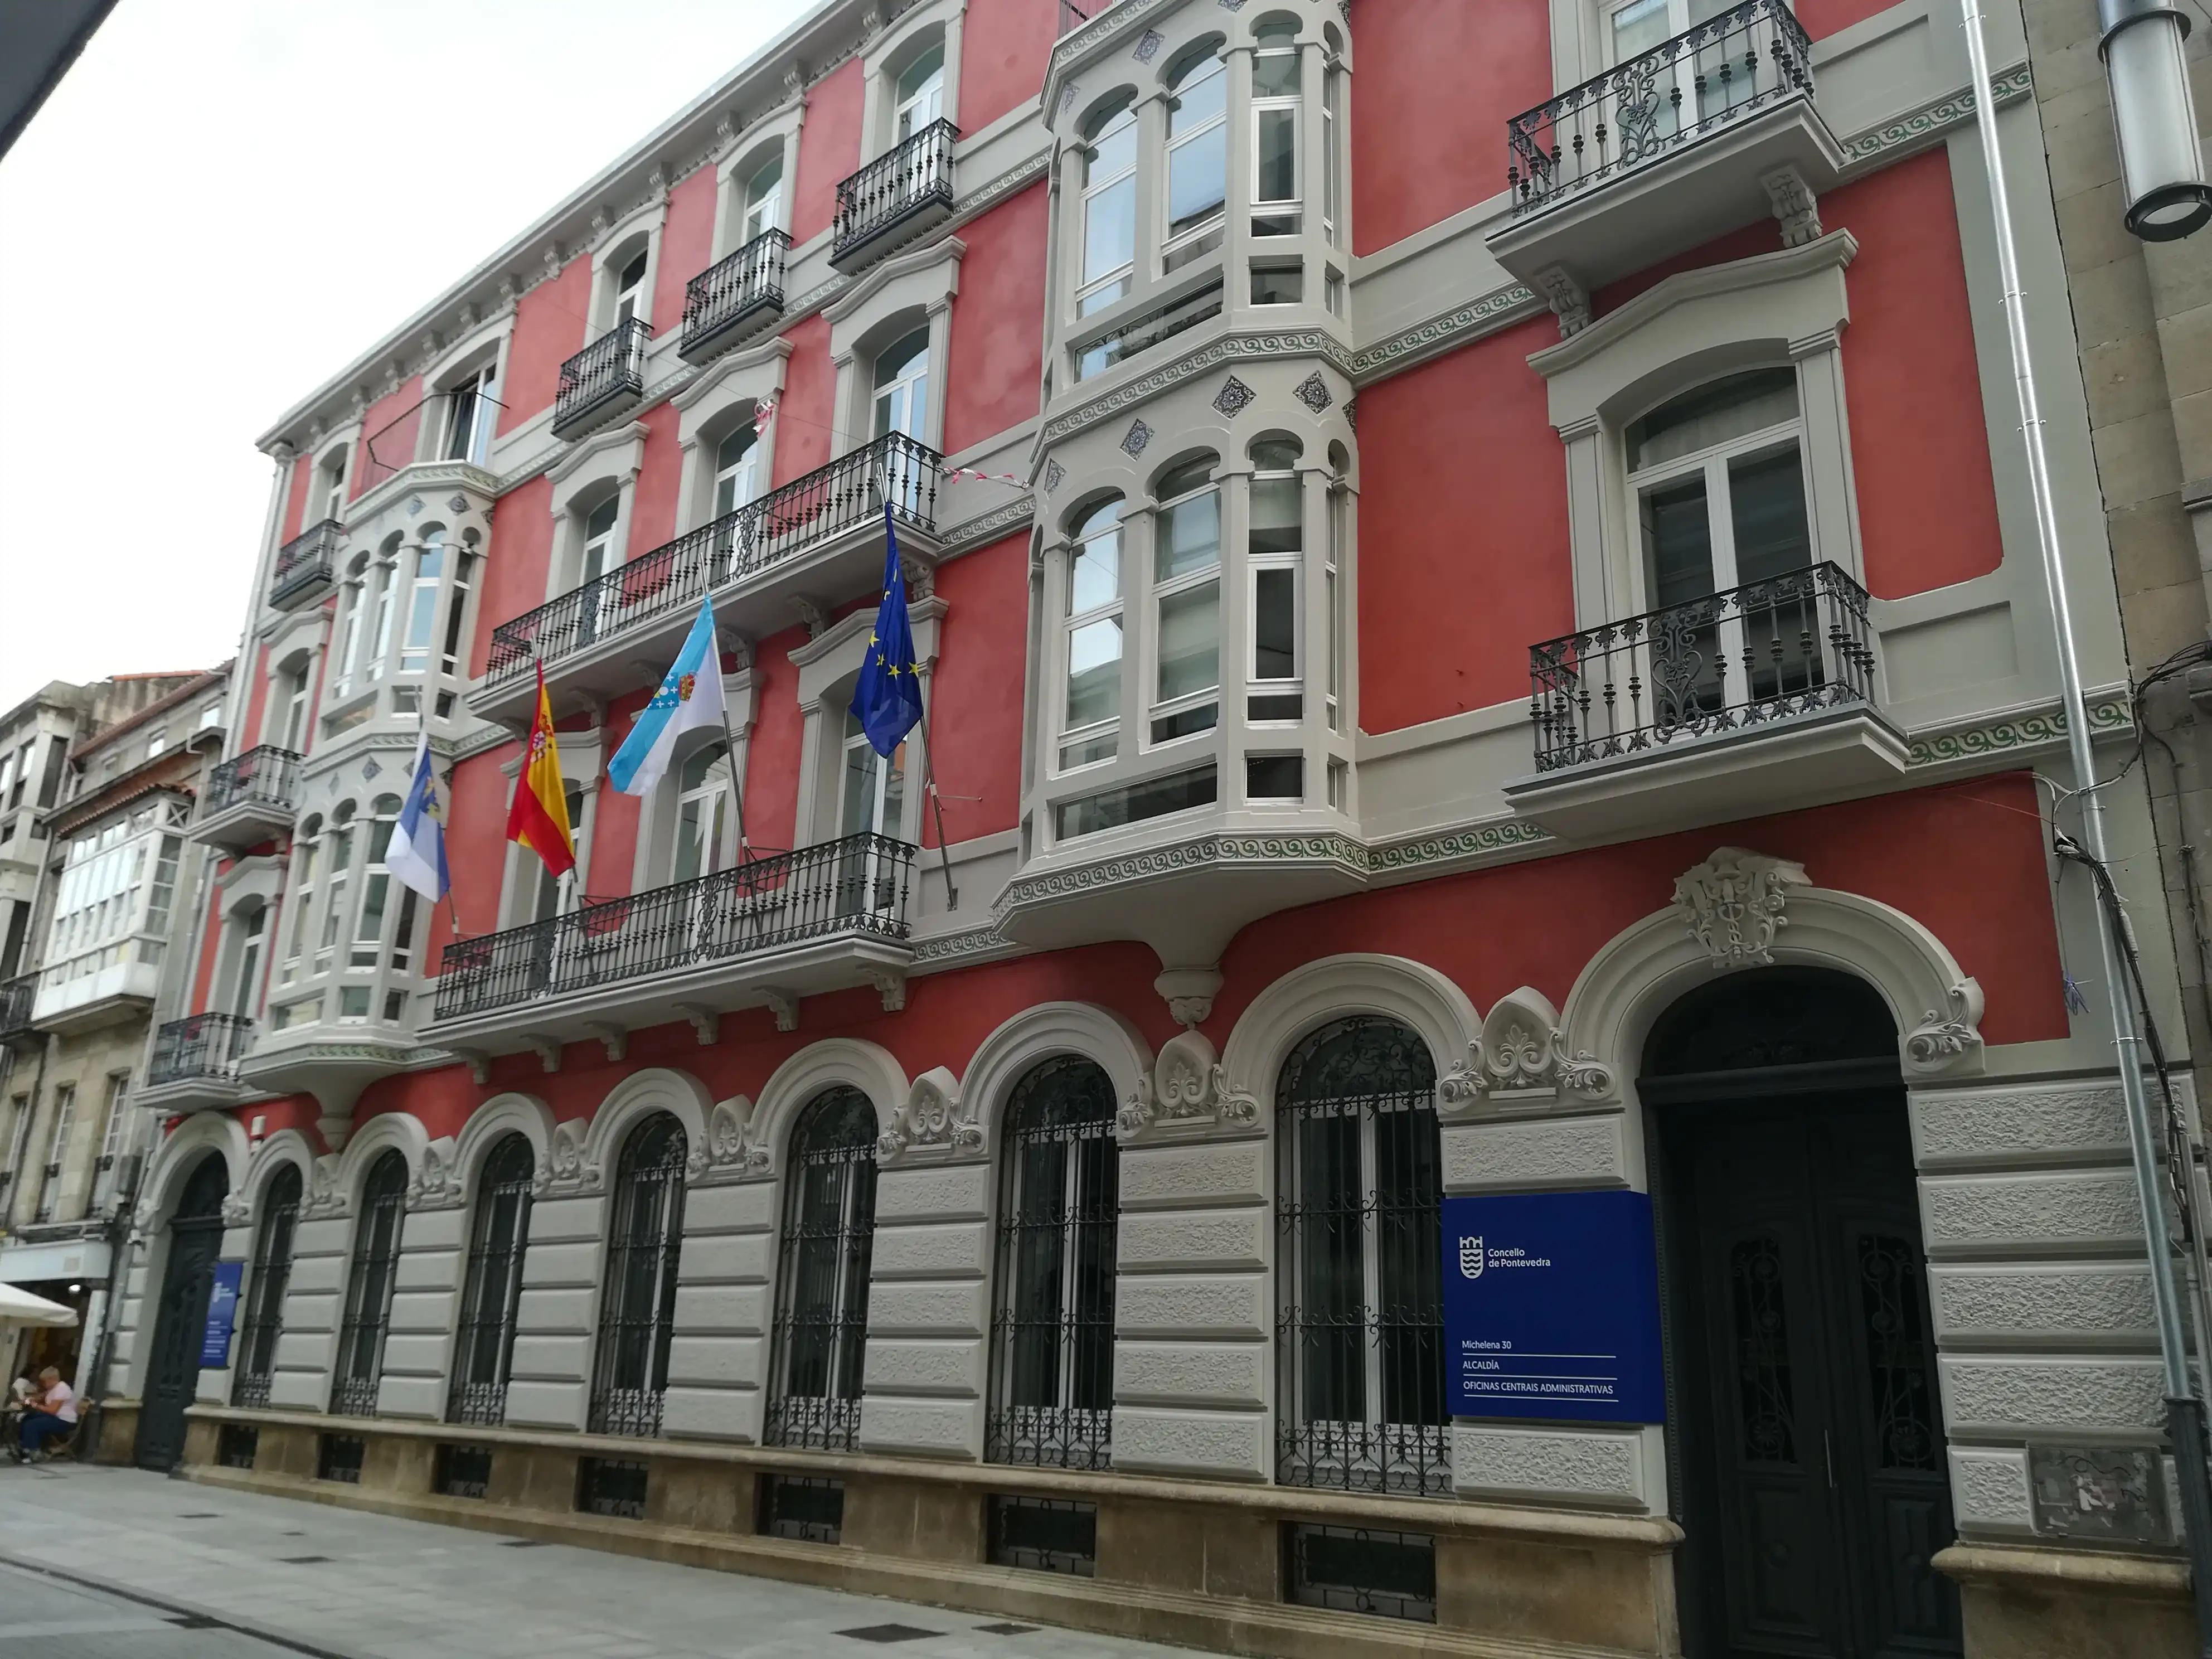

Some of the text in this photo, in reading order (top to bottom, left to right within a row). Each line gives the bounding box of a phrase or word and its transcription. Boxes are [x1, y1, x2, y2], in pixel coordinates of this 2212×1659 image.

[1488, 1248, 1525, 1257] Concello
[1488, 1258, 1550, 1267] de Pontevedra
[1462, 1340, 1511, 1349] Michelena 30
[1463, 1359, 1500, 1370] ALCALDÍA
[1463, 1381, 1613, 1394] OFICINAS CENTRAIS ADMINISTRATIVAS
